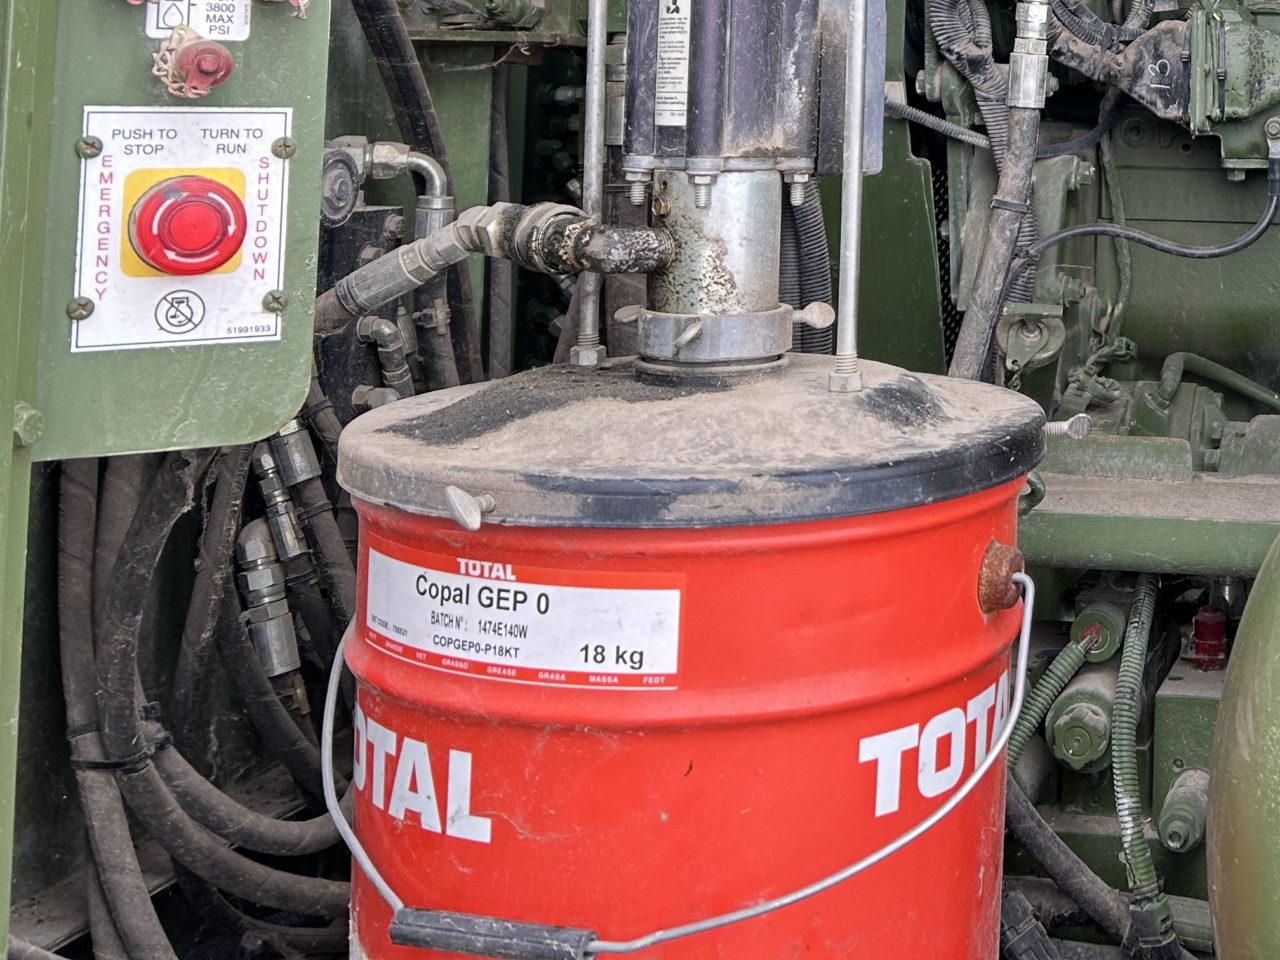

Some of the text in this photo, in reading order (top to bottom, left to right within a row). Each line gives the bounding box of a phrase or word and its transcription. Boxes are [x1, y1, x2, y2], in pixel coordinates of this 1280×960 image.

[205, 14, 234, 24] MAX
[206, 2, 235, 13] 3800
[209, 25, 230, 35] PSI
[111, 128, 177, 140] PUSH TO
[201, 127, 263, 139] TURN TO
[123, 144, 164, 155] STOP
[216, 143, 247, 154] RUN
[94, 154, 113, 300] EMERGENCY
[252, 156, 270, 280] SHUTDOWN
[456, 558, 516, 582] TOTAL
[415, 574, 470, 607] Copal
[477, 585, 528, 612] GEP
[430, 610, 454, 629] BATCH
[478, 619, 528, 639] 1474E140W
[433, 634, 520, 659] COPGEP0-P18KT
[579, 643, 645, 670] 18 kg
[441, 658, 469, 670] GRASSO
[487, 665, 517, 677] GREASE
[537, 671, 566, 681] GRASA
[588, 675, 619, 684] MASSA
[642, 675, 666, 684] FEDT
